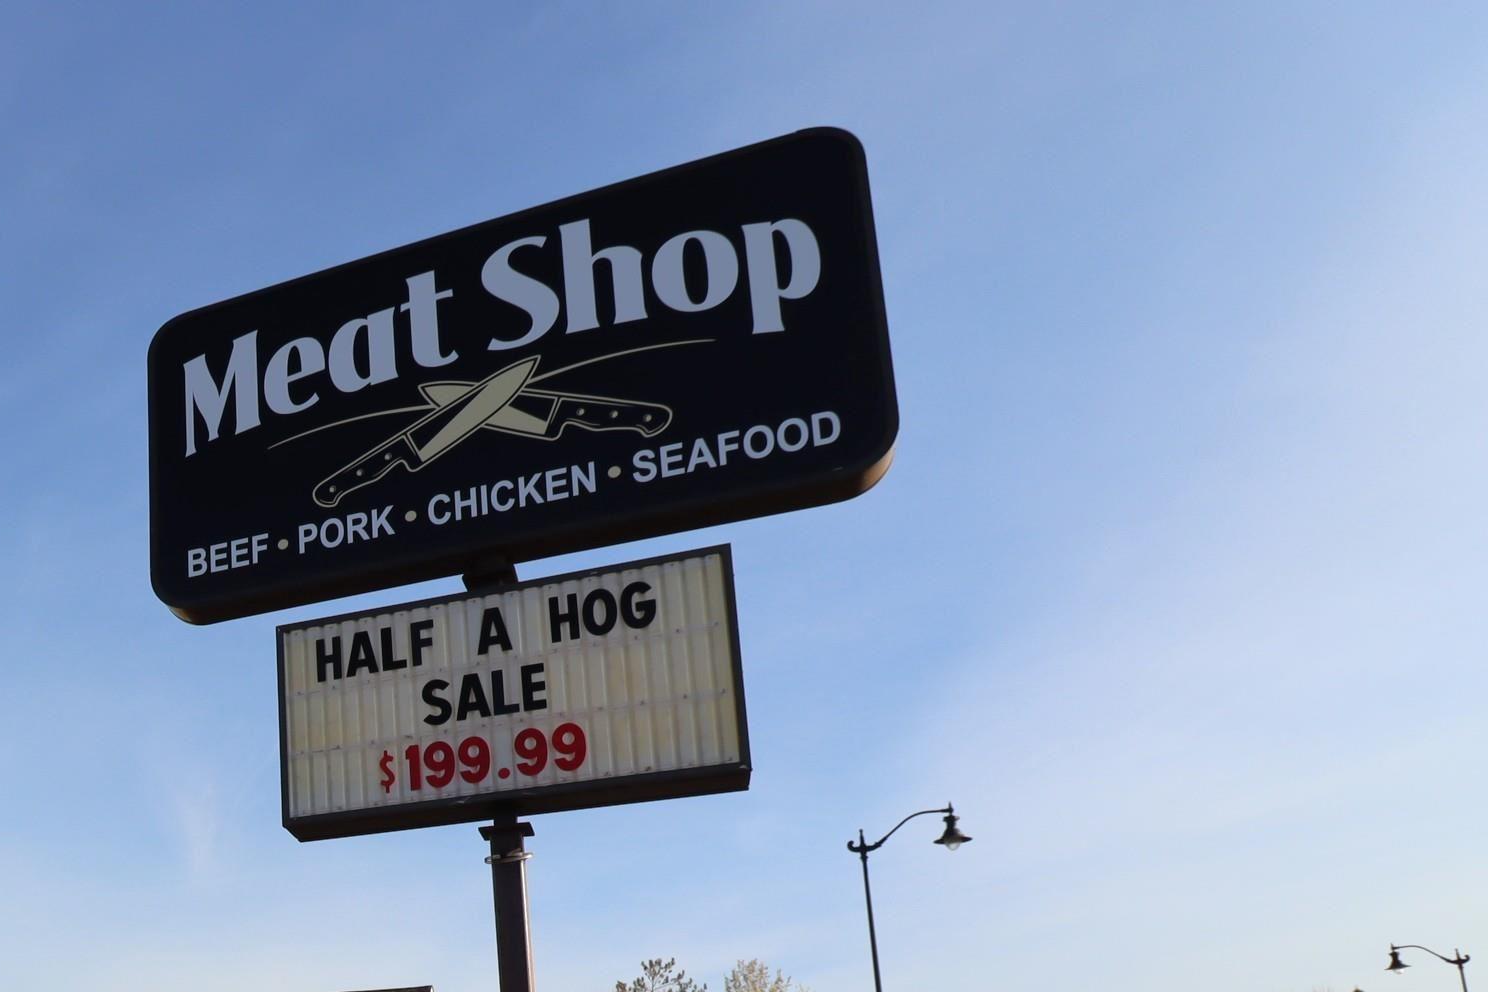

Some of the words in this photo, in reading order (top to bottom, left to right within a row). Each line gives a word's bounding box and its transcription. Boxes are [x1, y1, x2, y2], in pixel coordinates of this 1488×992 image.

[182, 268, 459, 458] Meat
[480, 217, 822, 351] Shop
[187, 532, 269, 579] BEEF
[297, 504, 395, 555] PORK
[426, 460, 597, 527] CHICKEN
[631, 410, 842, 483] SEAFOOD
[315, 618, 434, 683] HALF
[477, 606, 512, 656] A
[548, 580, 657, 644] HOG
[422, 662, 548, 725] SALE
[379, 722, 587, 794] $199.99
